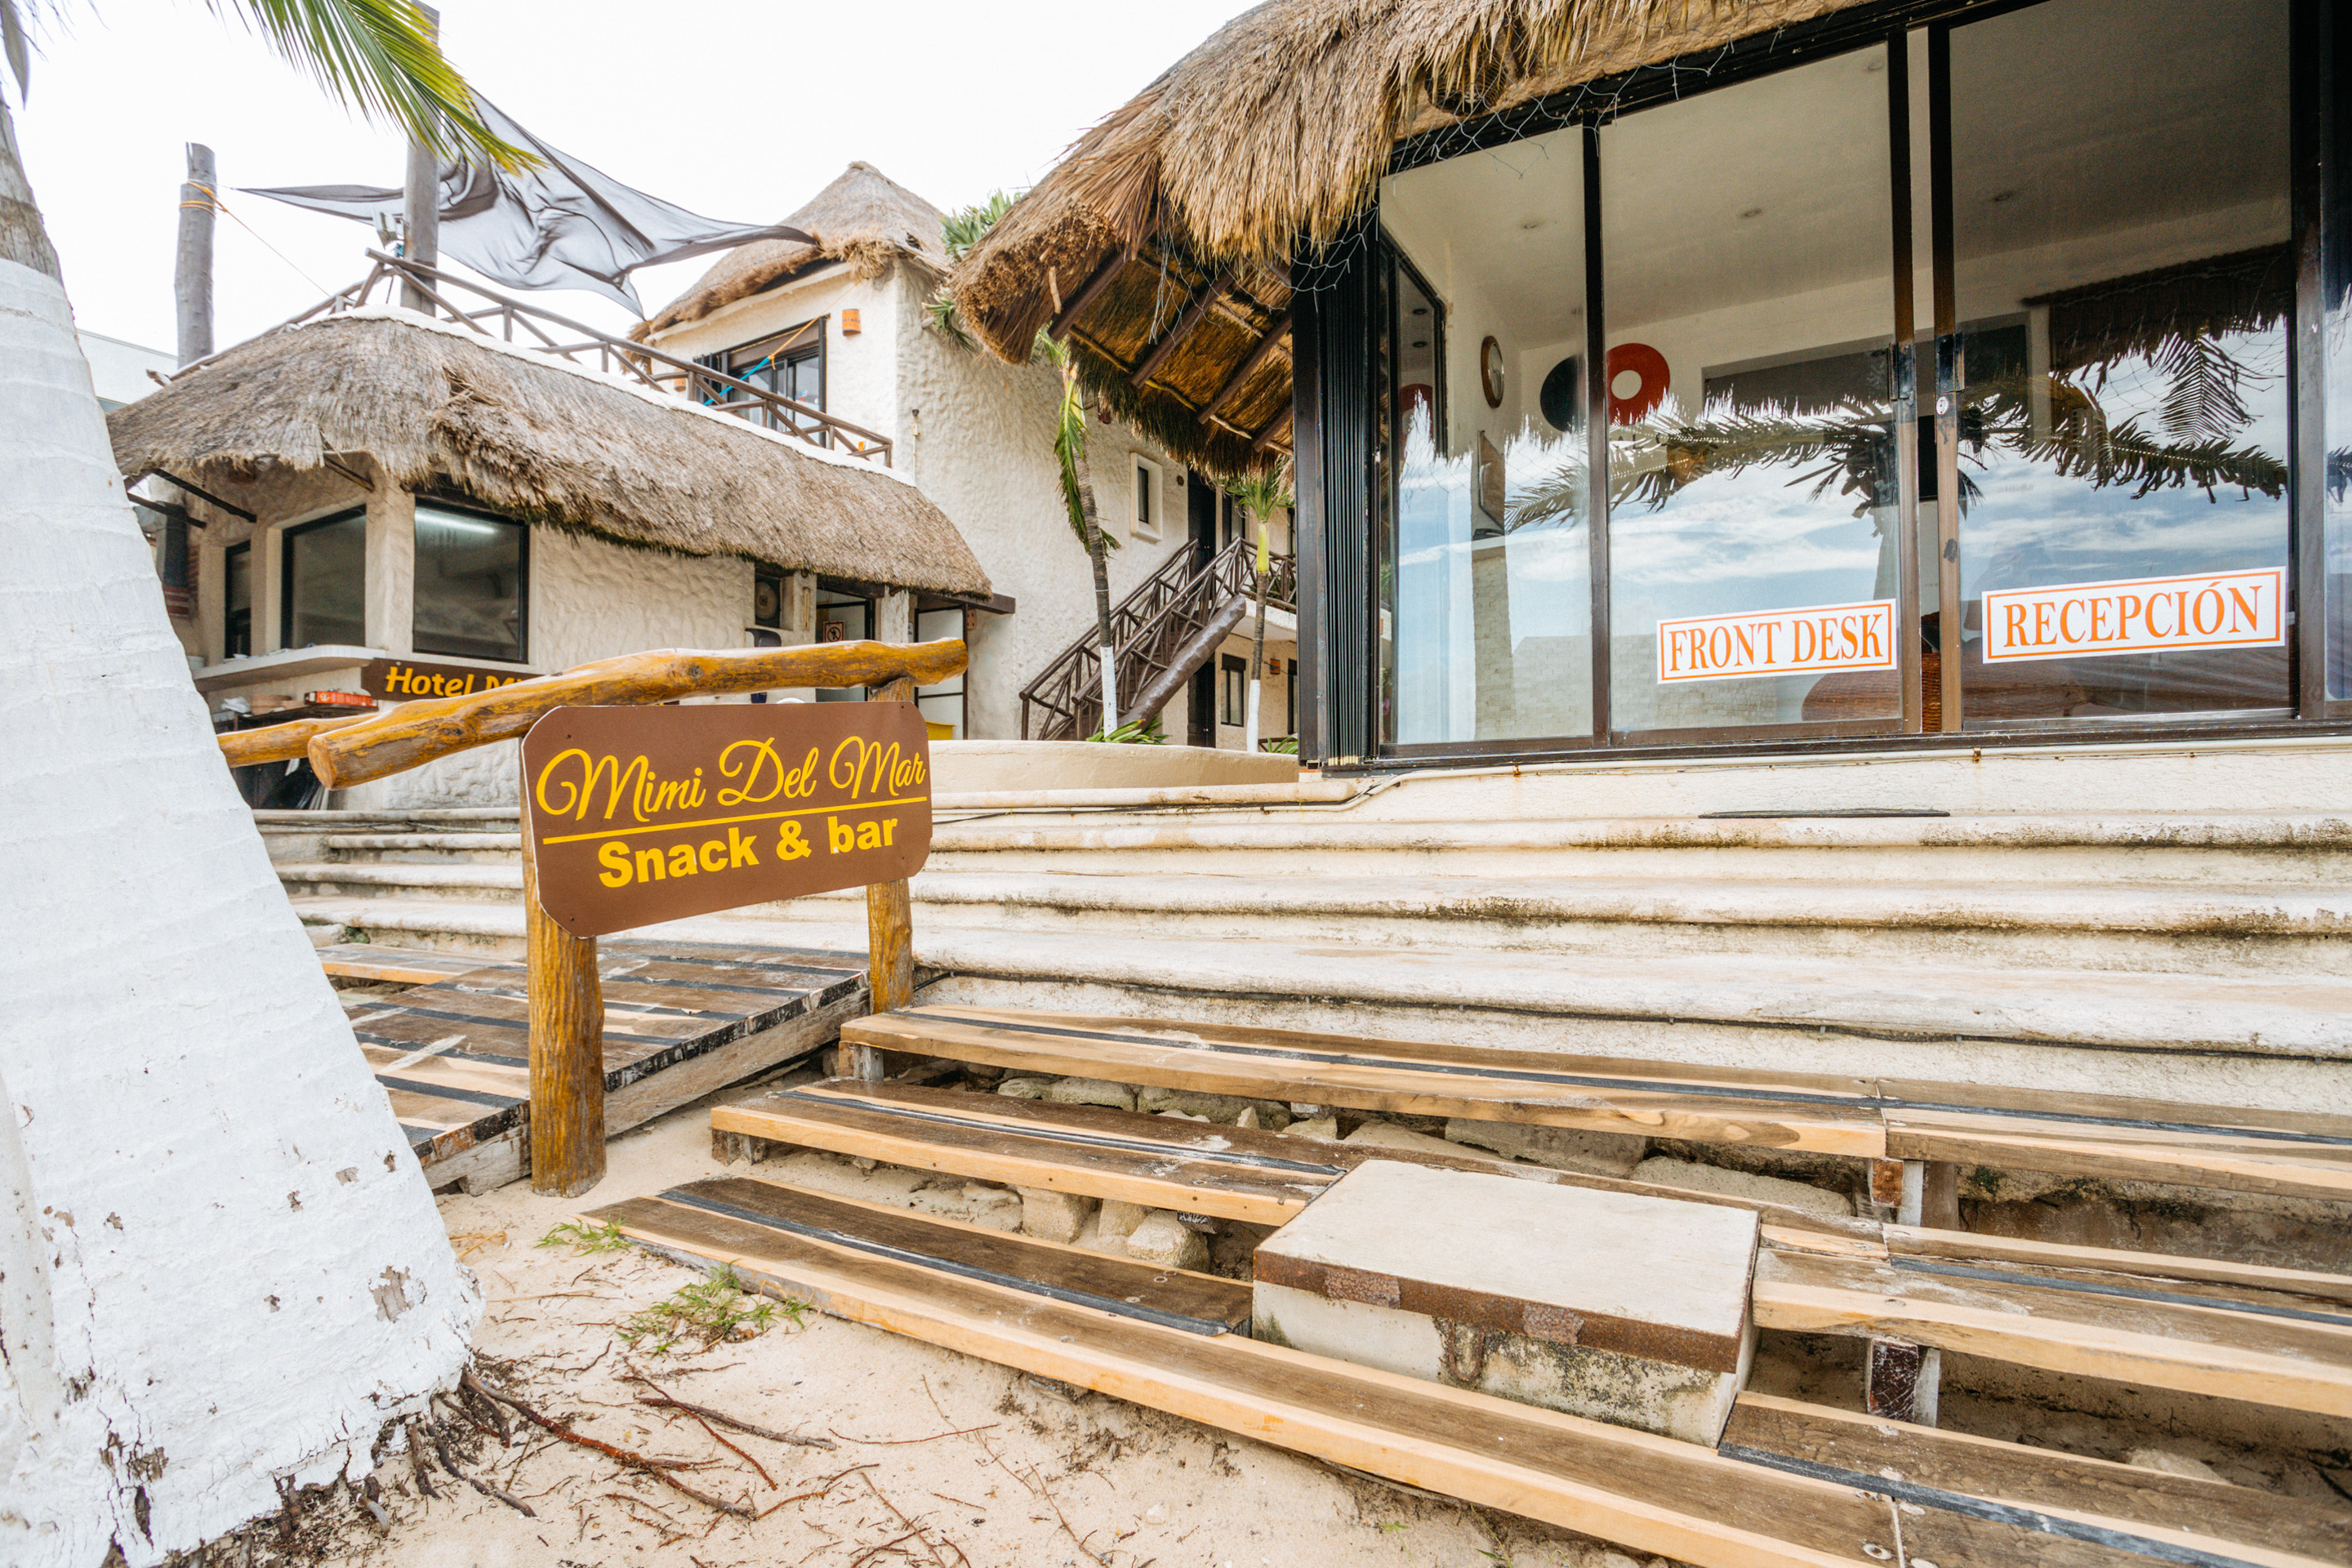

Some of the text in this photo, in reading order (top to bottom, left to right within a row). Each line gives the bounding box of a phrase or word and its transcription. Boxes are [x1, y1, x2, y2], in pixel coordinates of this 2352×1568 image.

[1668, 613, 1884, 671] FRONT DESK
[2002, 581, 2263, 648] RECEPCIÓN
[385, 666, 474, 697] Hotel
[536, 735, 926, 823] Mimi Del Mar
[597, 815, 898, 889] Snack & bar
